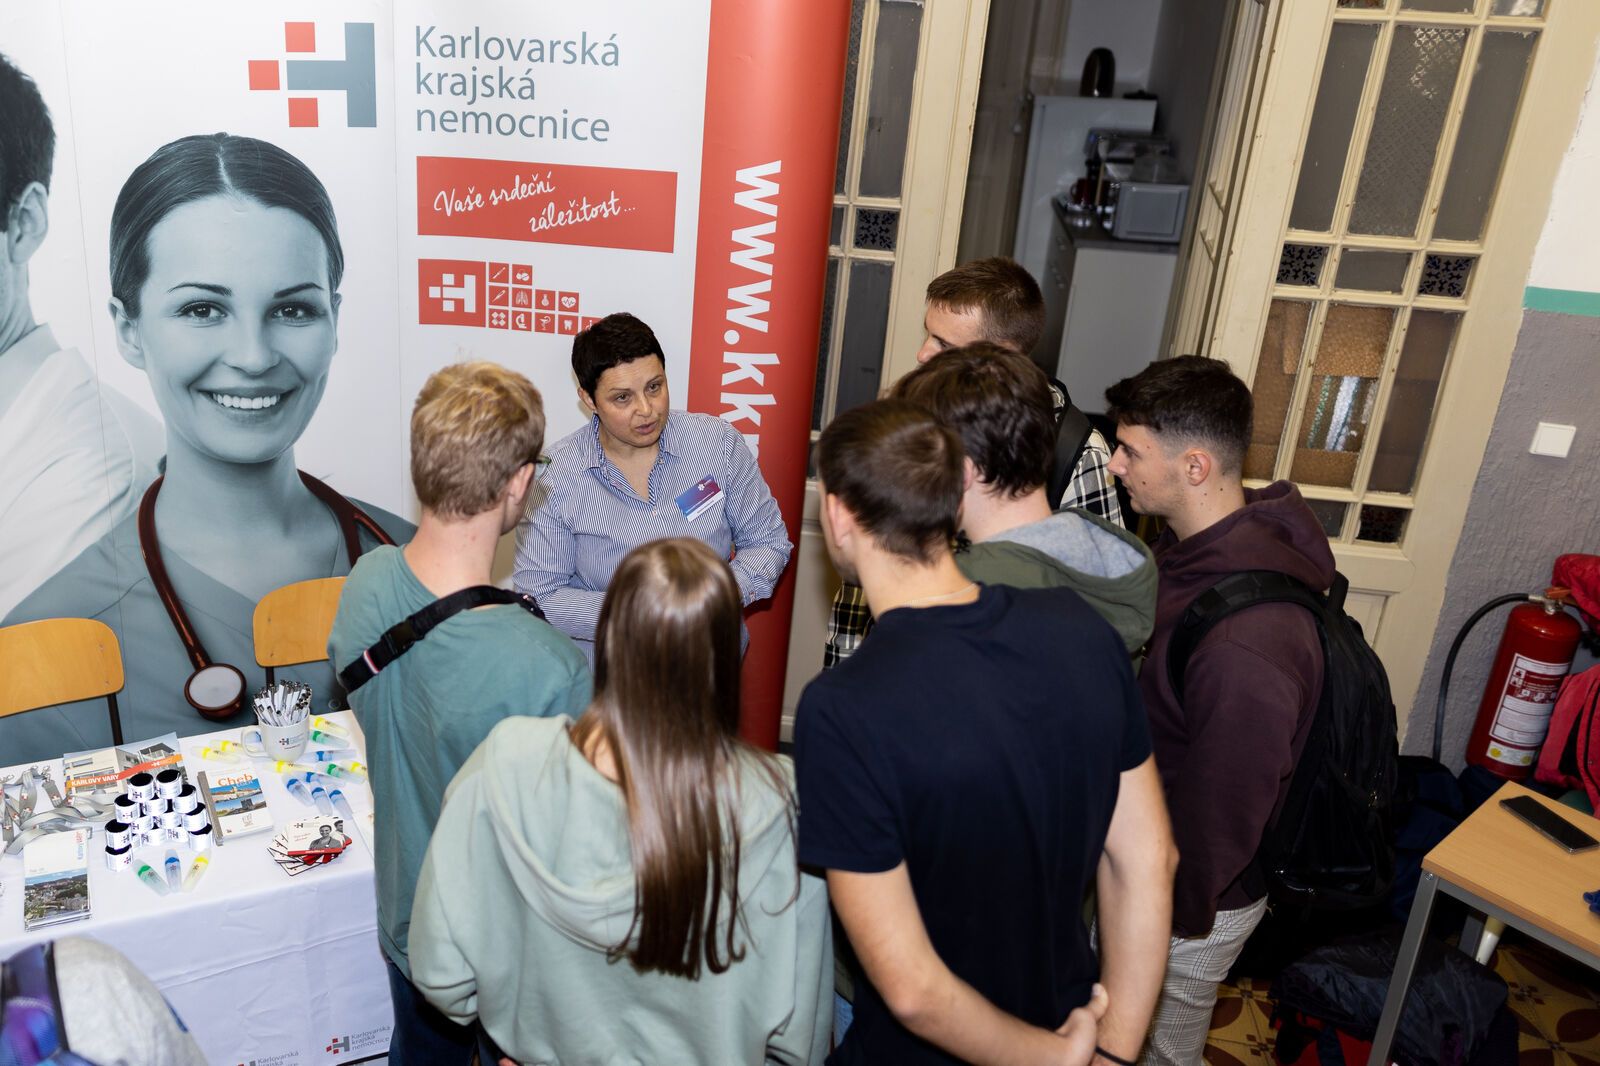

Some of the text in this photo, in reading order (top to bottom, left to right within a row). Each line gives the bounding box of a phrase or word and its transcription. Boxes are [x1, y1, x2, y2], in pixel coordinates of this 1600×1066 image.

[415, 25, 619, 67] Karlovarská
[415, 62, 536, 105] krajská
[416, 108, 610, 142] nemocnice
[433, 171, 556, 217] Vaše srdeční
[71, 774, 120, 787] KARLOVY VARY
[217, 773, 253, 786] Cheb
[257, 1051, 299, 1064] Karlovarská
